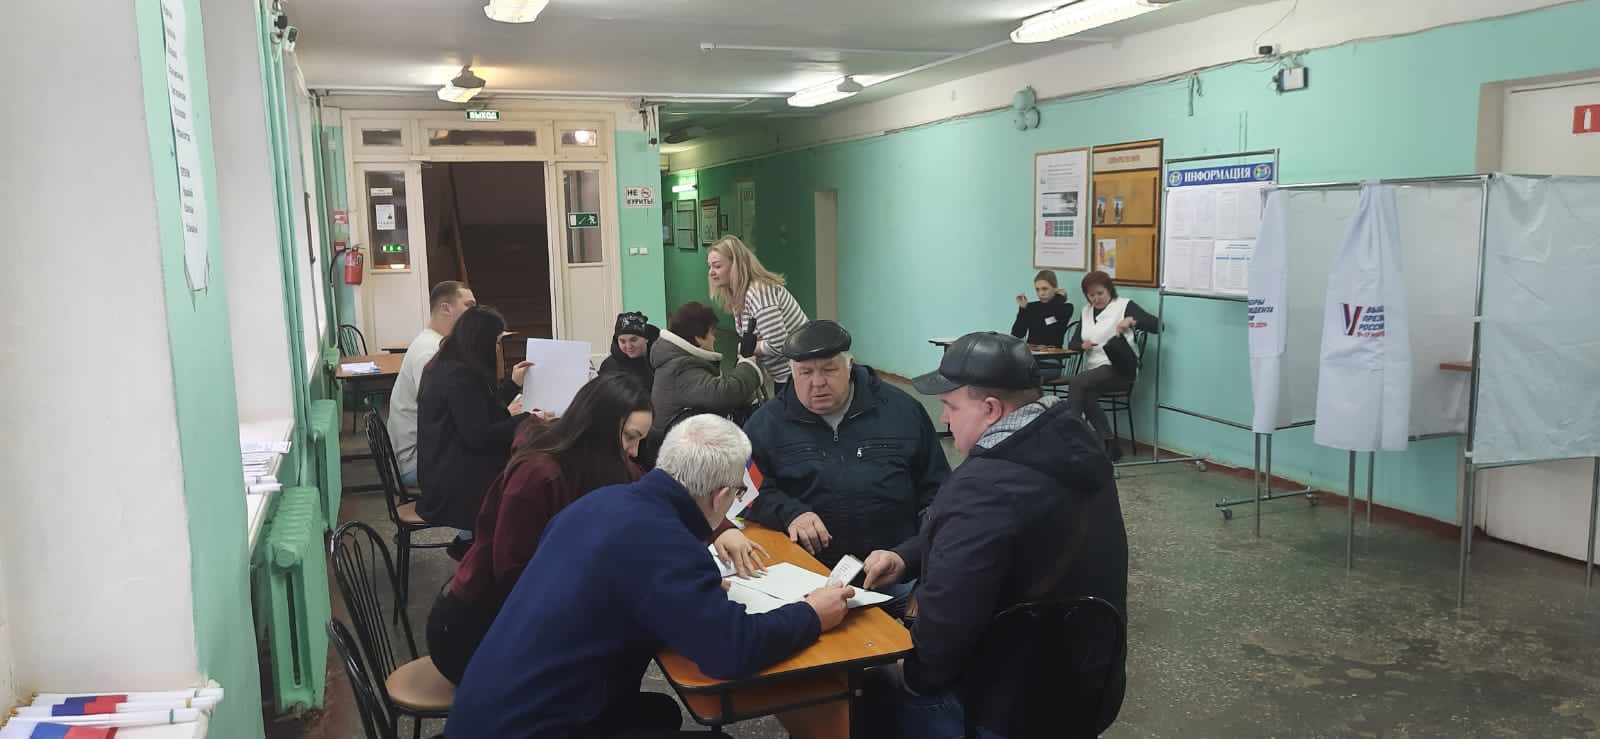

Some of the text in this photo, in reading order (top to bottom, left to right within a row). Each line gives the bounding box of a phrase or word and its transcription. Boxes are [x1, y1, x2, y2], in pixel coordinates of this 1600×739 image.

[469, 111, 497, 120] ВЫХОД
[1184, 167, 1251, 183] ИНФОРМАЦИЯ
[627, 189, 639, 197] НЕ
